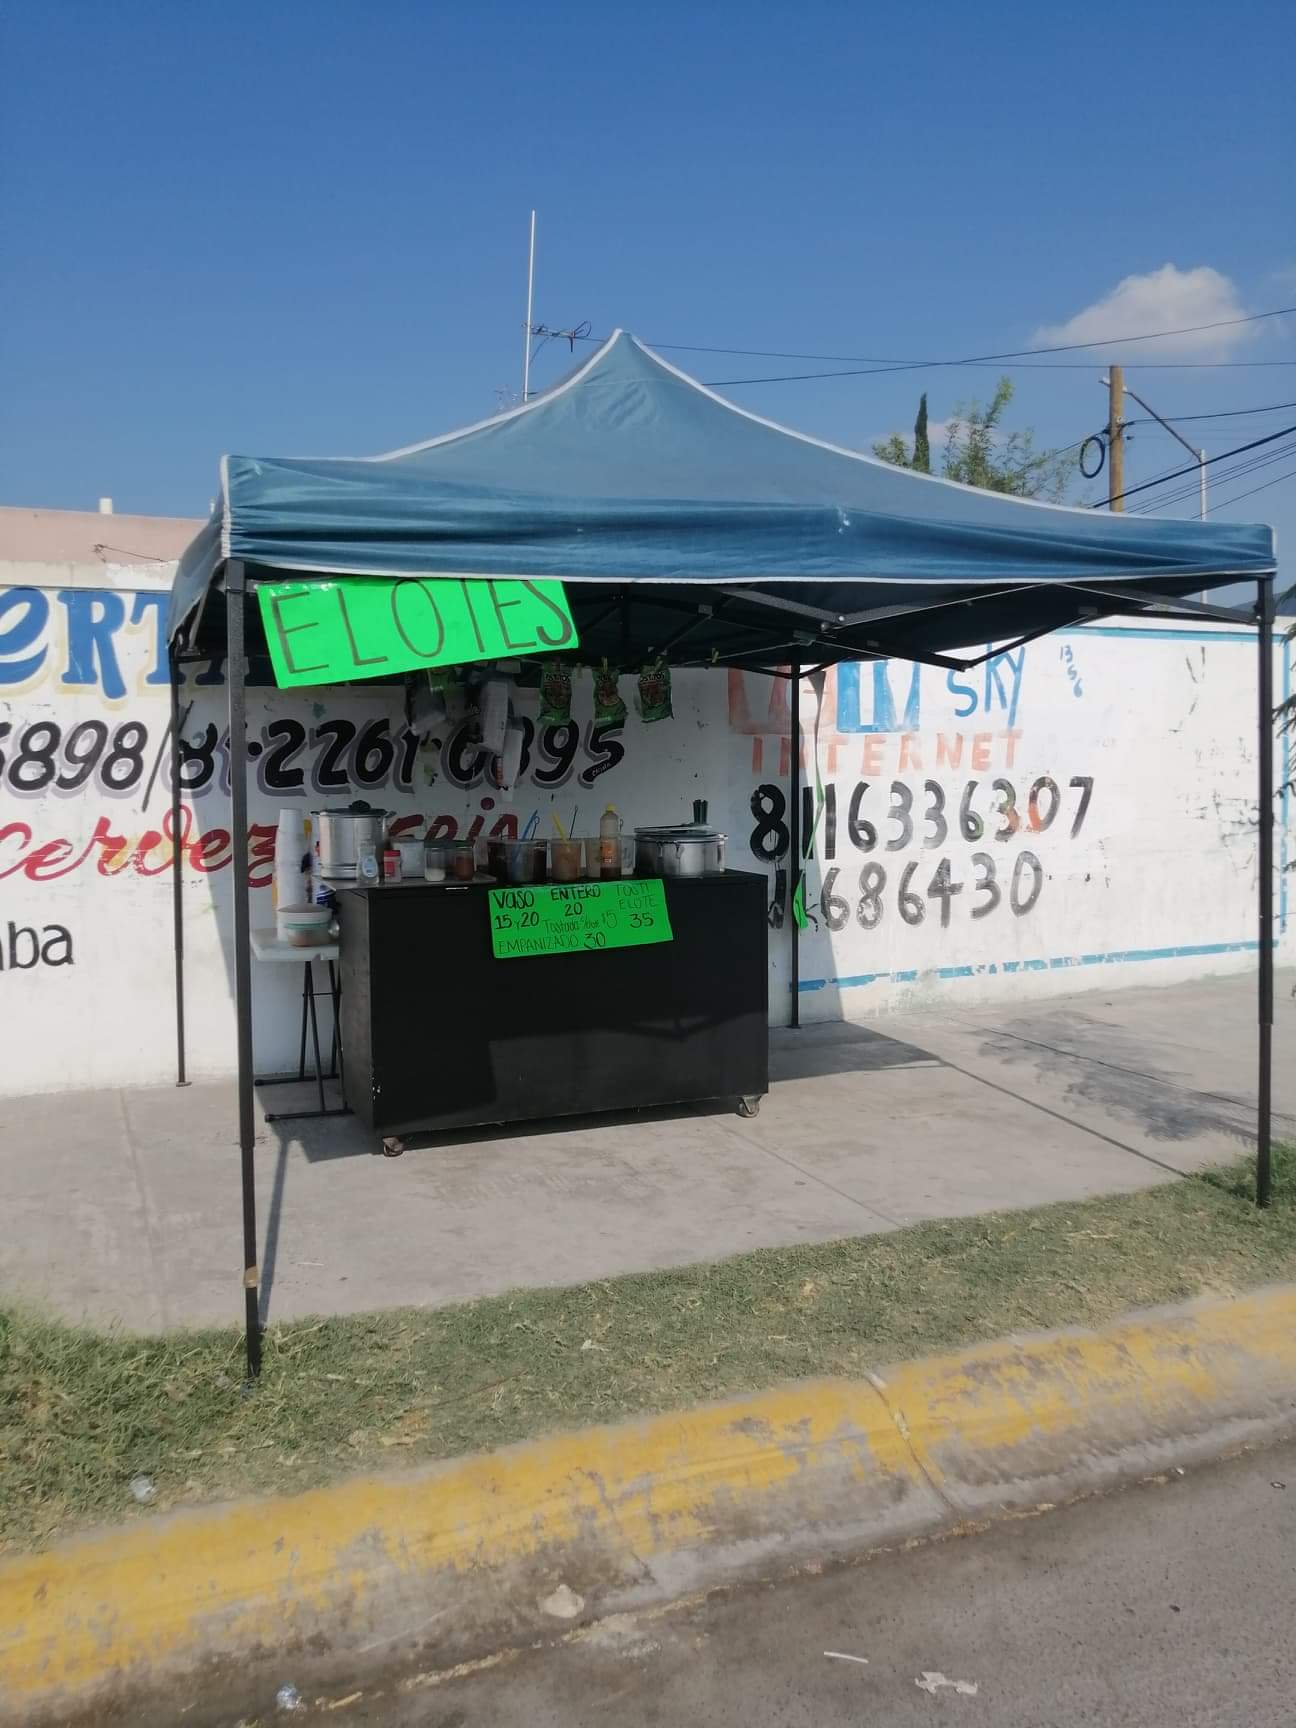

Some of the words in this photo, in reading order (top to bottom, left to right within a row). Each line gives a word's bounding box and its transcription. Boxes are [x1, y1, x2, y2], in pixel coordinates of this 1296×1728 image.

[272, 578, 573, 674] ELOTES
[752, 730, 1024, 777] INTERNET
[750, 776, 1094, 864] 8116336307
[493, 889, 535, 910] VASO
[551, 884, 602, 901] ENTERO
[564, 902, 583, 917] 20
[495, 914, 513, 930] 15
[521, 911, 540, 928] 20
[629, 912, 654, 929] 35
[0, 919, 76, 972] ba
[583, 931, 606, 950] 30
